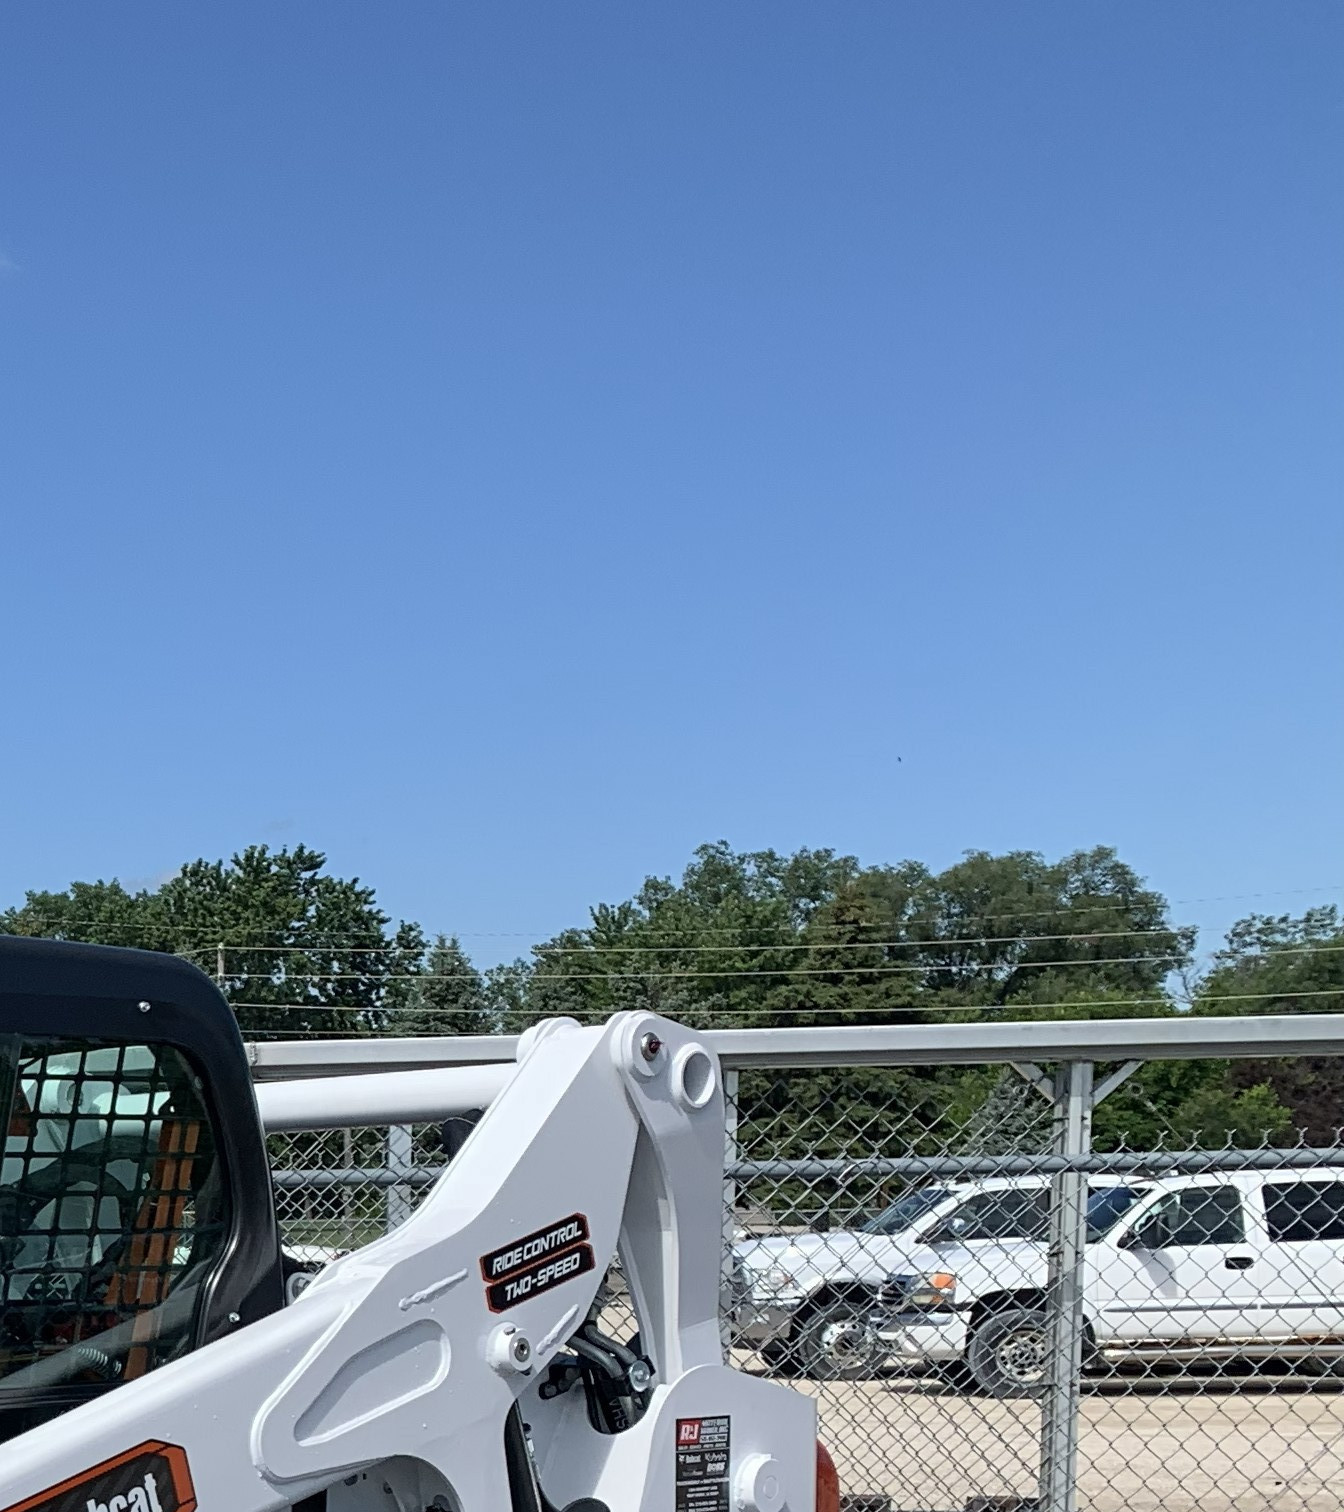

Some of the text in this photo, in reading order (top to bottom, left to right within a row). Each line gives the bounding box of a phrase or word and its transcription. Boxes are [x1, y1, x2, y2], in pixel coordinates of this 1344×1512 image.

[492, 1221, 583, 1276] RIDE CONTROL
[504, 1252, 581, 1302] TWO-SPEED
